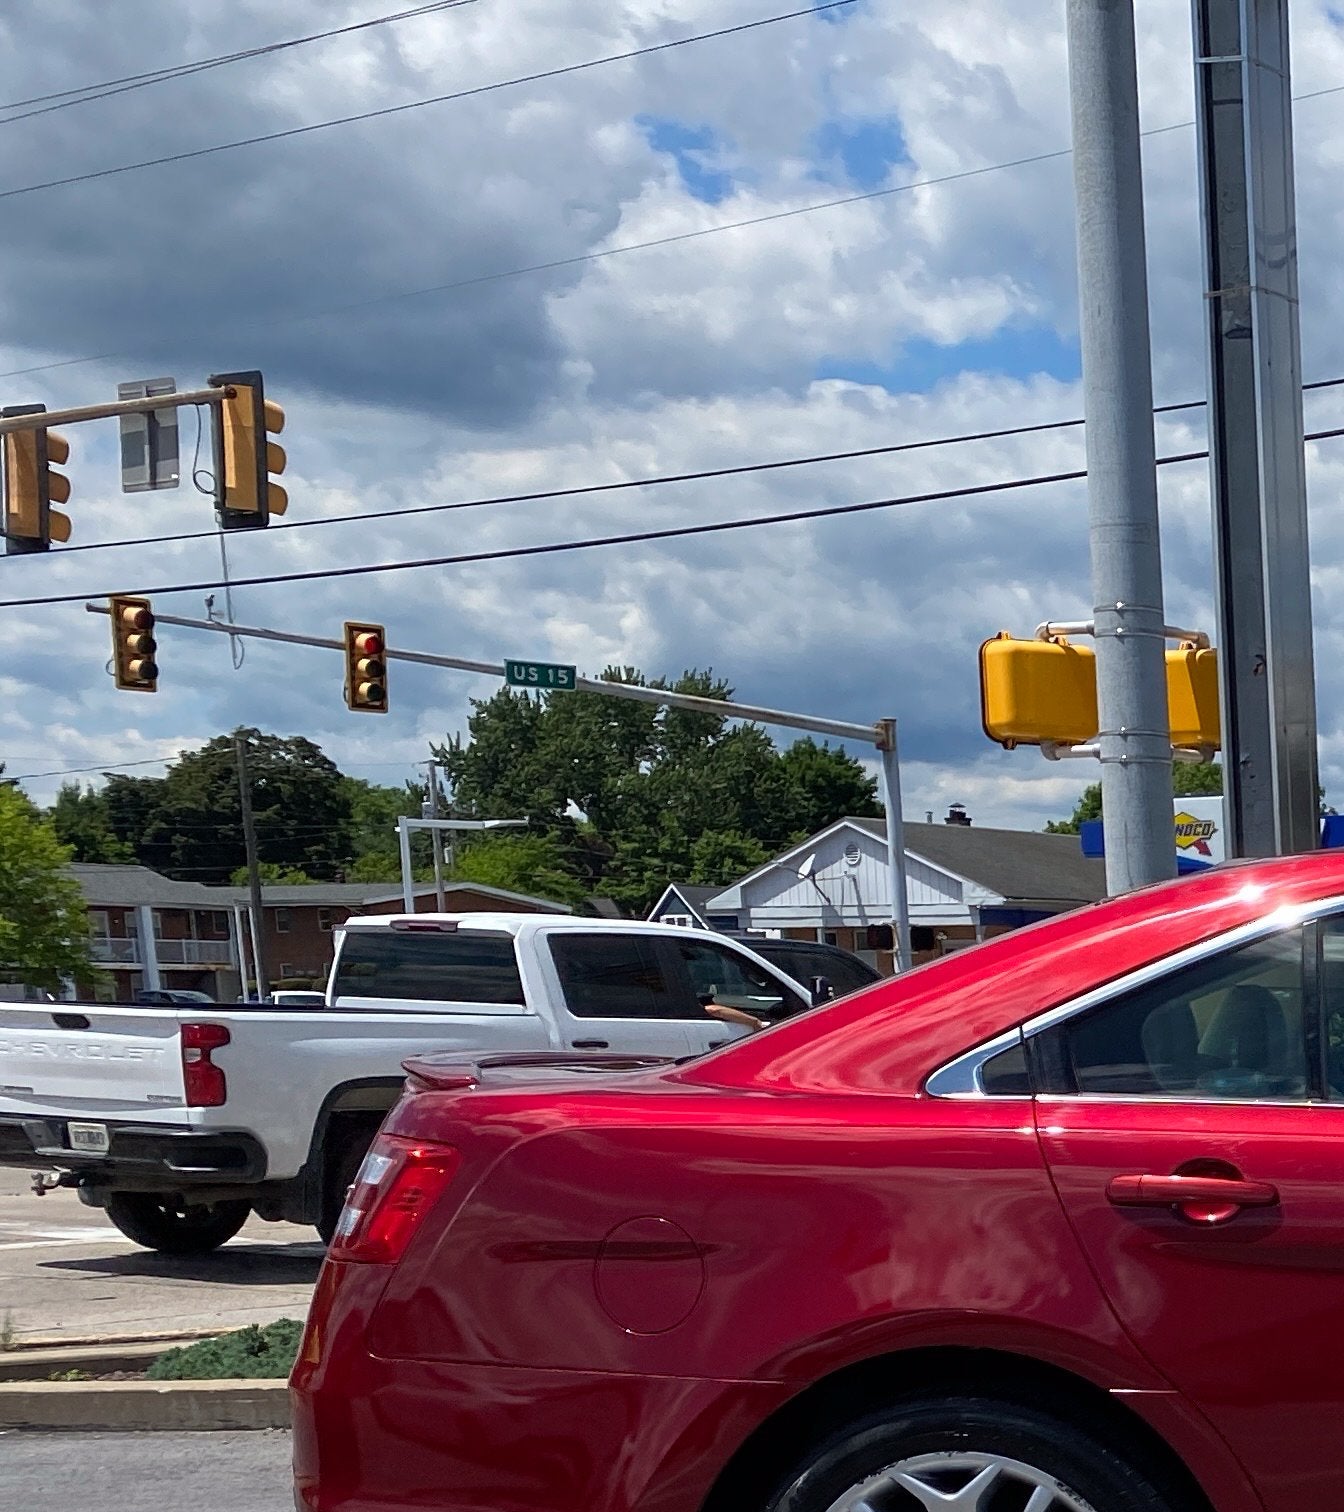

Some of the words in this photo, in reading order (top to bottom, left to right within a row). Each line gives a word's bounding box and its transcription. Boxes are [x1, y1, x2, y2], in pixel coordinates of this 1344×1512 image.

[513, 665, 538, 682] US
[547, 668, 569, 685] 15
[1175, 823, 1212, 837] NOCO
